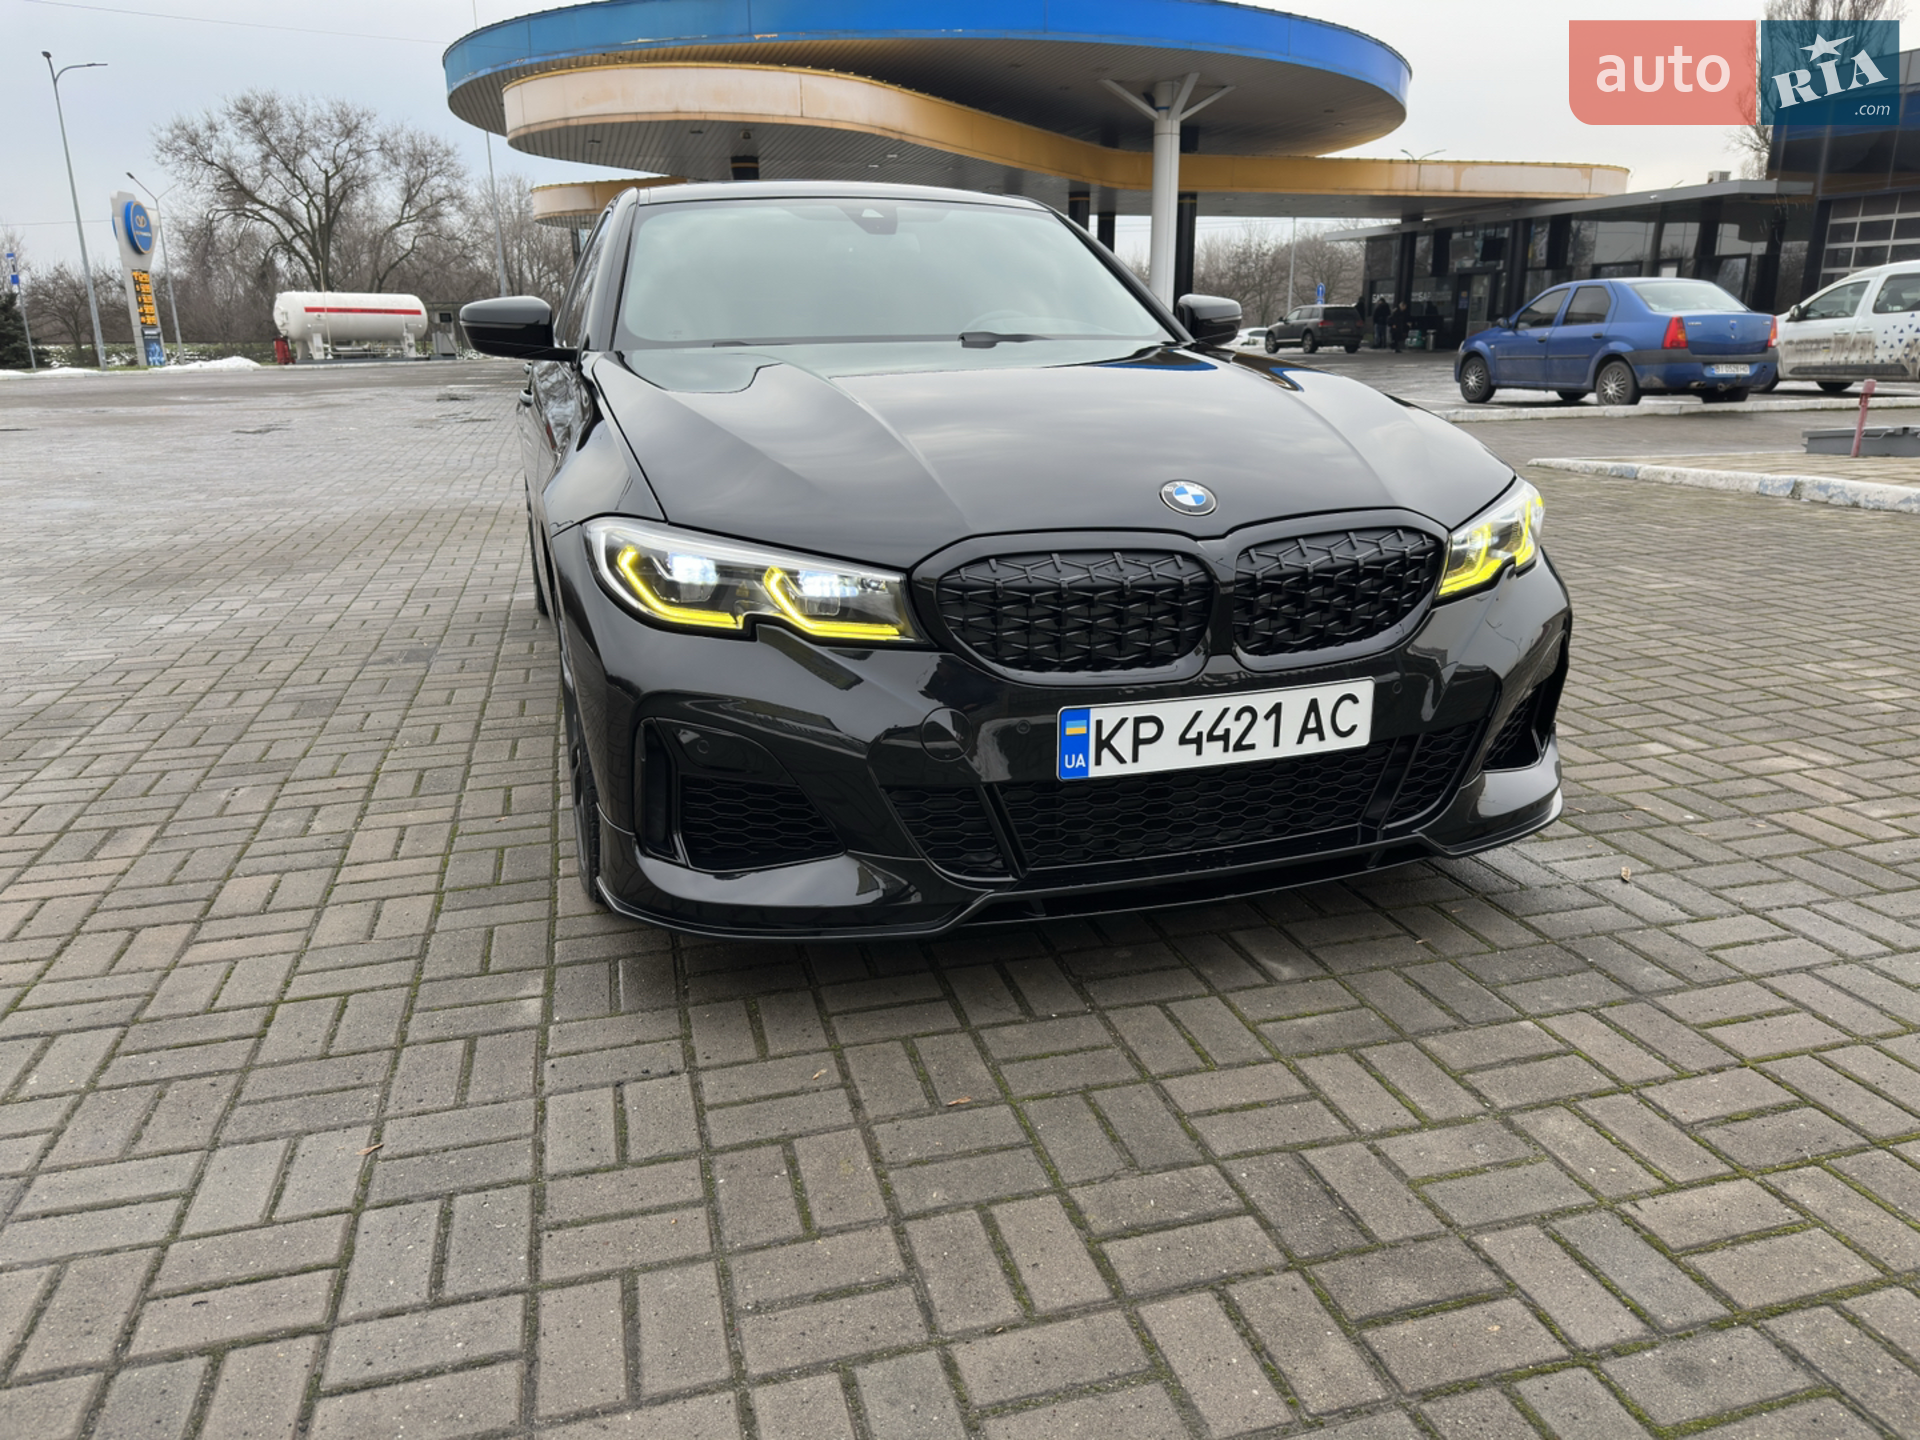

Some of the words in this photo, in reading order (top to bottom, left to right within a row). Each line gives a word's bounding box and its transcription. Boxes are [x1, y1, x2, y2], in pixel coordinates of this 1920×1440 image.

[1094, 715, 1165, 767] KP
[1178, 701, 1283, 756] 4421
[1296, 692, 1360, 745] AC
[1064, 753, 1086, 769] UA
